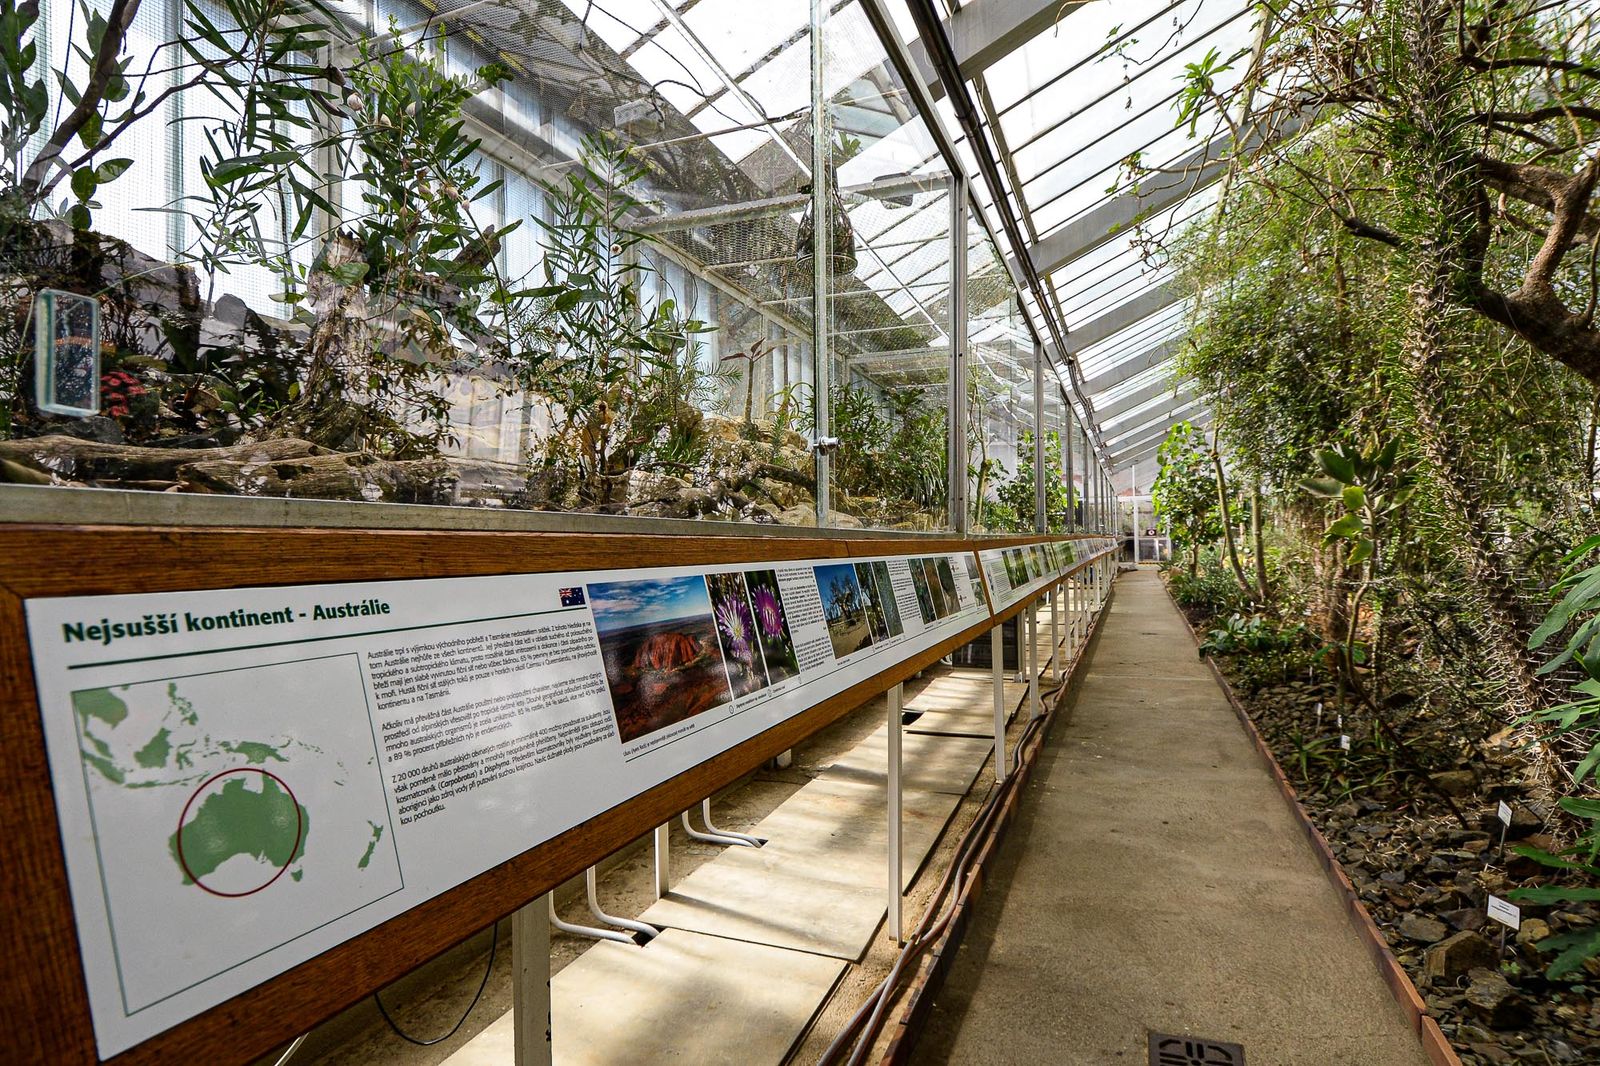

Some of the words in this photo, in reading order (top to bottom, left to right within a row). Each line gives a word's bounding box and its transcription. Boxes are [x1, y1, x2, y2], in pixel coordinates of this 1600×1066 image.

[62, 613, 178, 645] Nejsušší
[185, 607, 294, 631] kontinent
[314, 599, 390, 620] Austrálie
[367, 649, 394, 660] Austrálie
[394, 647, 405, 657] trpí
[410, 644, 436, 654] výjimkou
[369, 662, 383, 670] tom
[383, 657, 410, 668] Austrálie
[410, 654, 433, 664] nejhůře
[371, 668, 404, 680] tropického
[410, 661, 449, 673] subtropického
[373, 681, 389, 691] břeží
[389, 678, 404, 687] mají
[403, 677, 414, 686] jen
[414, 673, 430, 683] slabě
[381, 690, 398, 700] moři.
[397, 686, 416, 696] Hustá
[416, 683, 430, 692] říční
[377, 698, 411, 711] kontinentu
[425, 689, 452, 701] Tasmánii.
[382, 720, 404, 732] Ačkoliv
[415, 711, 441, 725] převážná
[440, 708, 452, 717] část
[384, 728, 411, 744] prostředí
[420, 719, 450, 733] alpinských
[386, 740, 409, 752] mnoho
[409, 730, 444, 746] australských
[412, 743, 435, 757] procent
[435, 734, 465, 751] příbřežních
[407, 768, 421, 779] 000
[421, 762, 439, 774] druhů
[439, 752, 471, 769] australských
[395, 783, 409, 794] však
[409, 773, 437, 791] poměrně
[437, 769, 453, 780] málo
[396, 784, 437, 804] kosmatcovník
[437, 770, 479, 792] (Carpobrotus)
[399, 798, 427, 815] aboriginci
[427, 794, 441, 806] jako
[440, 788, 455, 800] zdroj
[455, 784, 469, 794] vody
[401, 816, 413, 825] kou
[413, 804, 446, 822] pochoutku.
